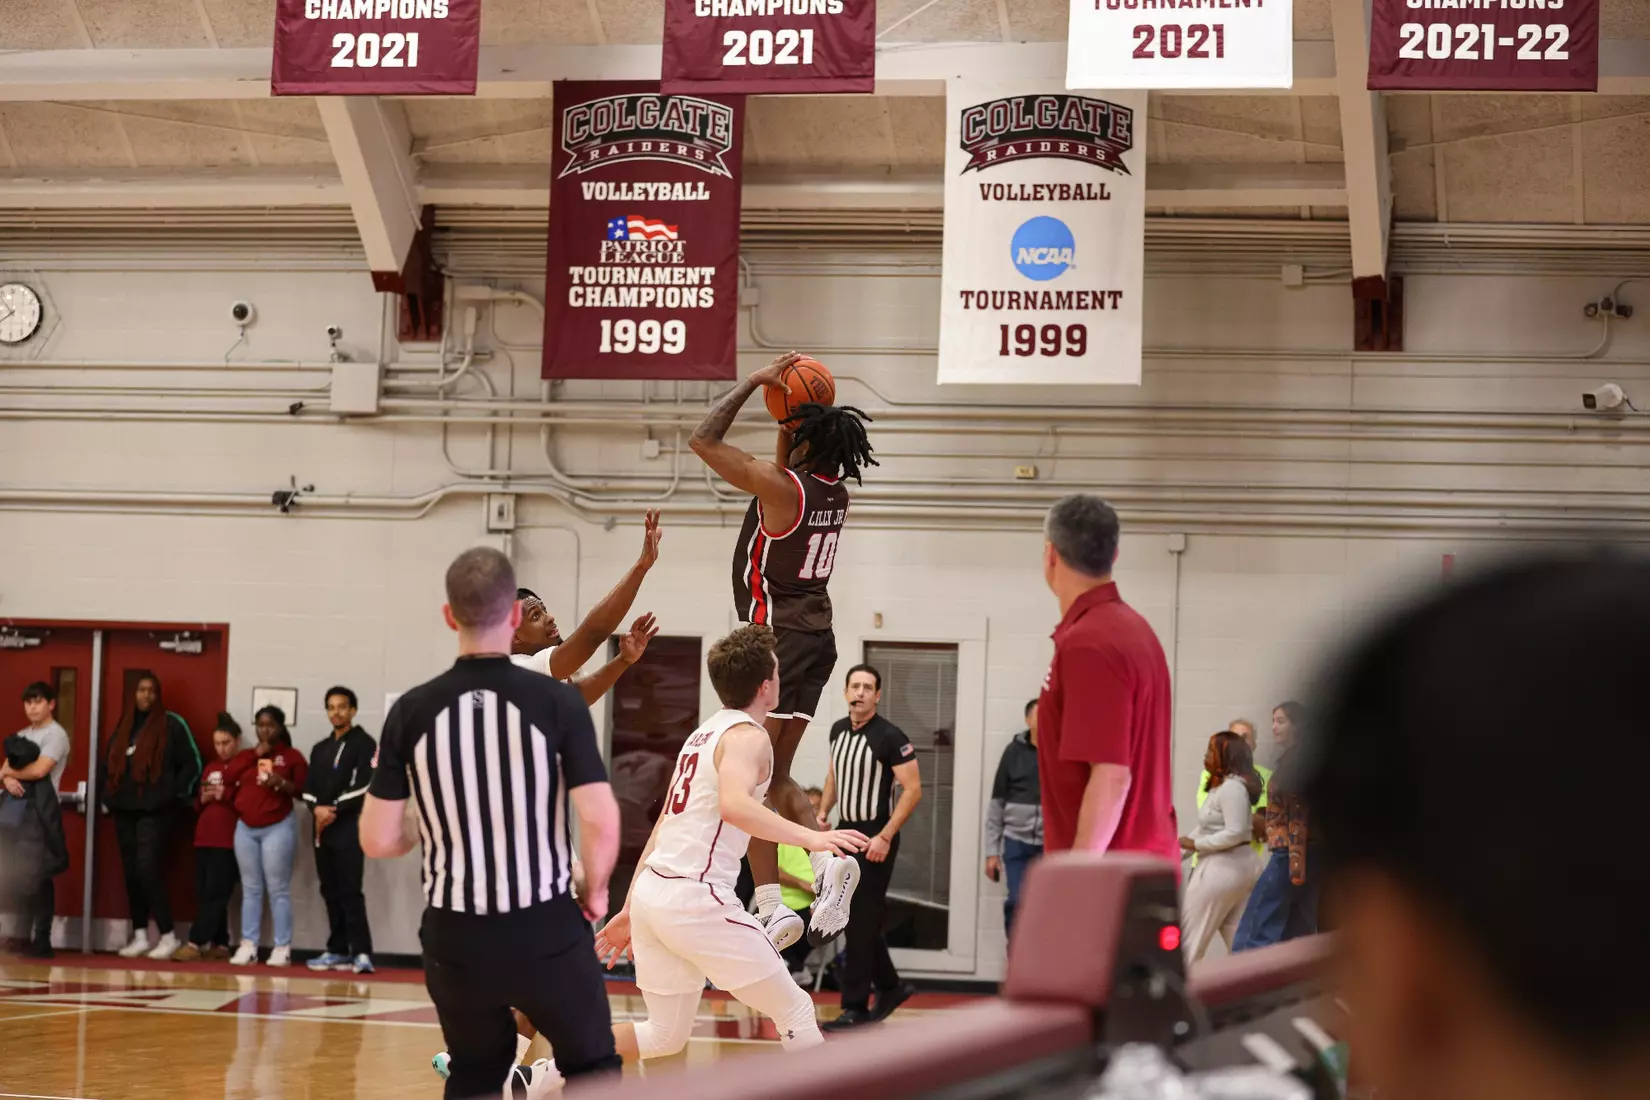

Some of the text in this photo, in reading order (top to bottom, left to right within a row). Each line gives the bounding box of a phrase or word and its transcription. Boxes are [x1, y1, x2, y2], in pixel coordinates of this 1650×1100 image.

[305, 0, 449, 19] CHAMPIONS
[331, 33, 419, 68] 2021
[723, 29, 814, 66] 2021
[1132, 24, 1224, 59] 2021
[1399, 23, 1570, 60] 2021-22
[567, 97, 729, 144] COLGATE
[962, 96, 1131, 145] COLGATE
[590, 142, 705, 161] RAIDERS
[986, 141, 1106, 161] RAIDERS
[581, 182, 710, 201] VOLLEYBALL
[979, 183, 1111, 201] VOLLEYBALL
[601, 240, 687, 253] PATRIOT
[1016, 247, 1075, 265] NCAA
[600, 252, 685, 264] LEAGUE
[569, 267, 715, 285] TOURNAMENT
[568, 287, 714, 308] CHAMPIONS
[960, 290, 1123, 310] TOURNAMENT
[600, 319, 686, 354] 1999
[999, 324, 1087, 357] 1999
[808, 511, 833, 527] LILLY
[799, 531, 838, 579] 10
[664, 752, 699, 815] 13
